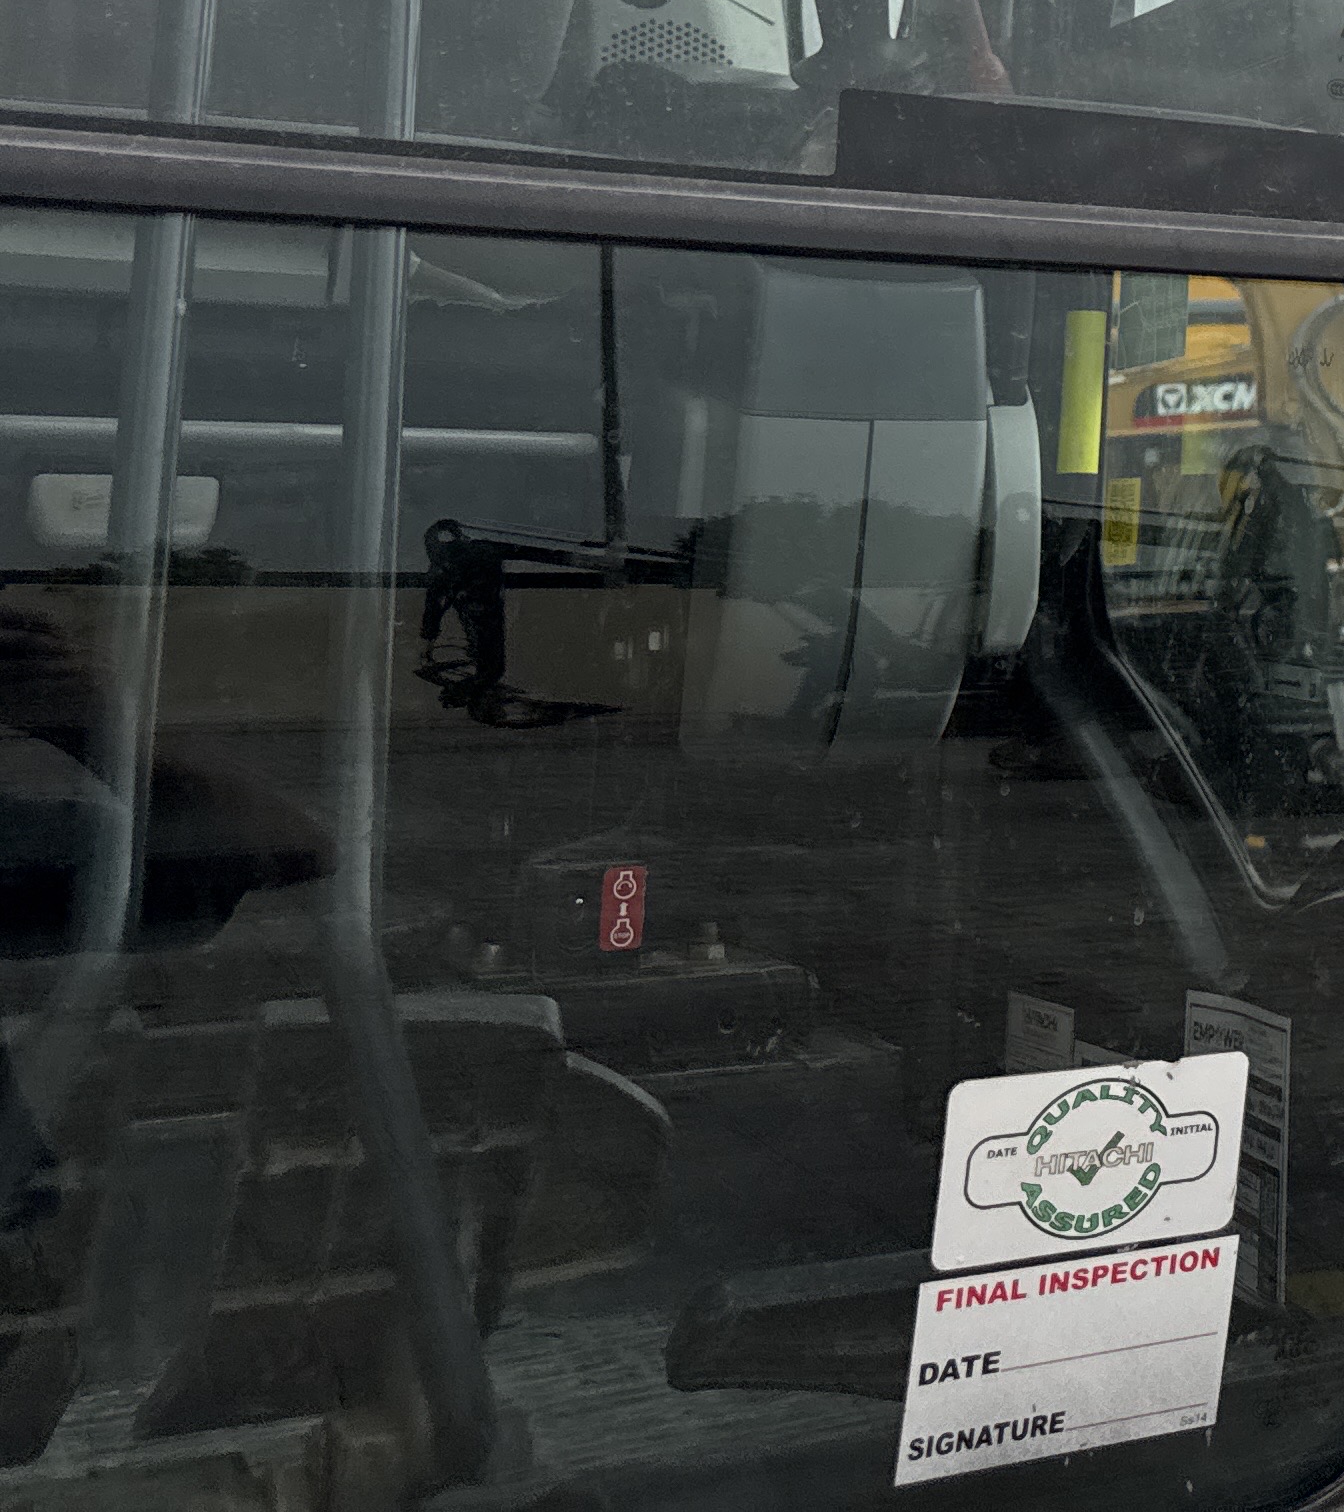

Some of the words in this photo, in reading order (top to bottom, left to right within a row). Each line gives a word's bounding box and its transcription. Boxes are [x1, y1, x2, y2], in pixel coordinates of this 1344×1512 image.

[1187, 381, 1258, 415] XCM
[1026, 1085, 1168, 1155] QUALITY
[1170, 1121, 1214, 1137] INITIAL
[987, 1146, 1018, 1160] DATE
[1034, 1142, 1155, 1178] HITACHI
[1020, 1163, 1162, 1234] ASSURED
[936, 1286, 1028, 1313] FINAL
[1038, 1246, 1221, 1297] INSPECTION
[918, 1350, 1002, 1387] DATE
[908, 1410, 1067, 1462] SIGNATURE
